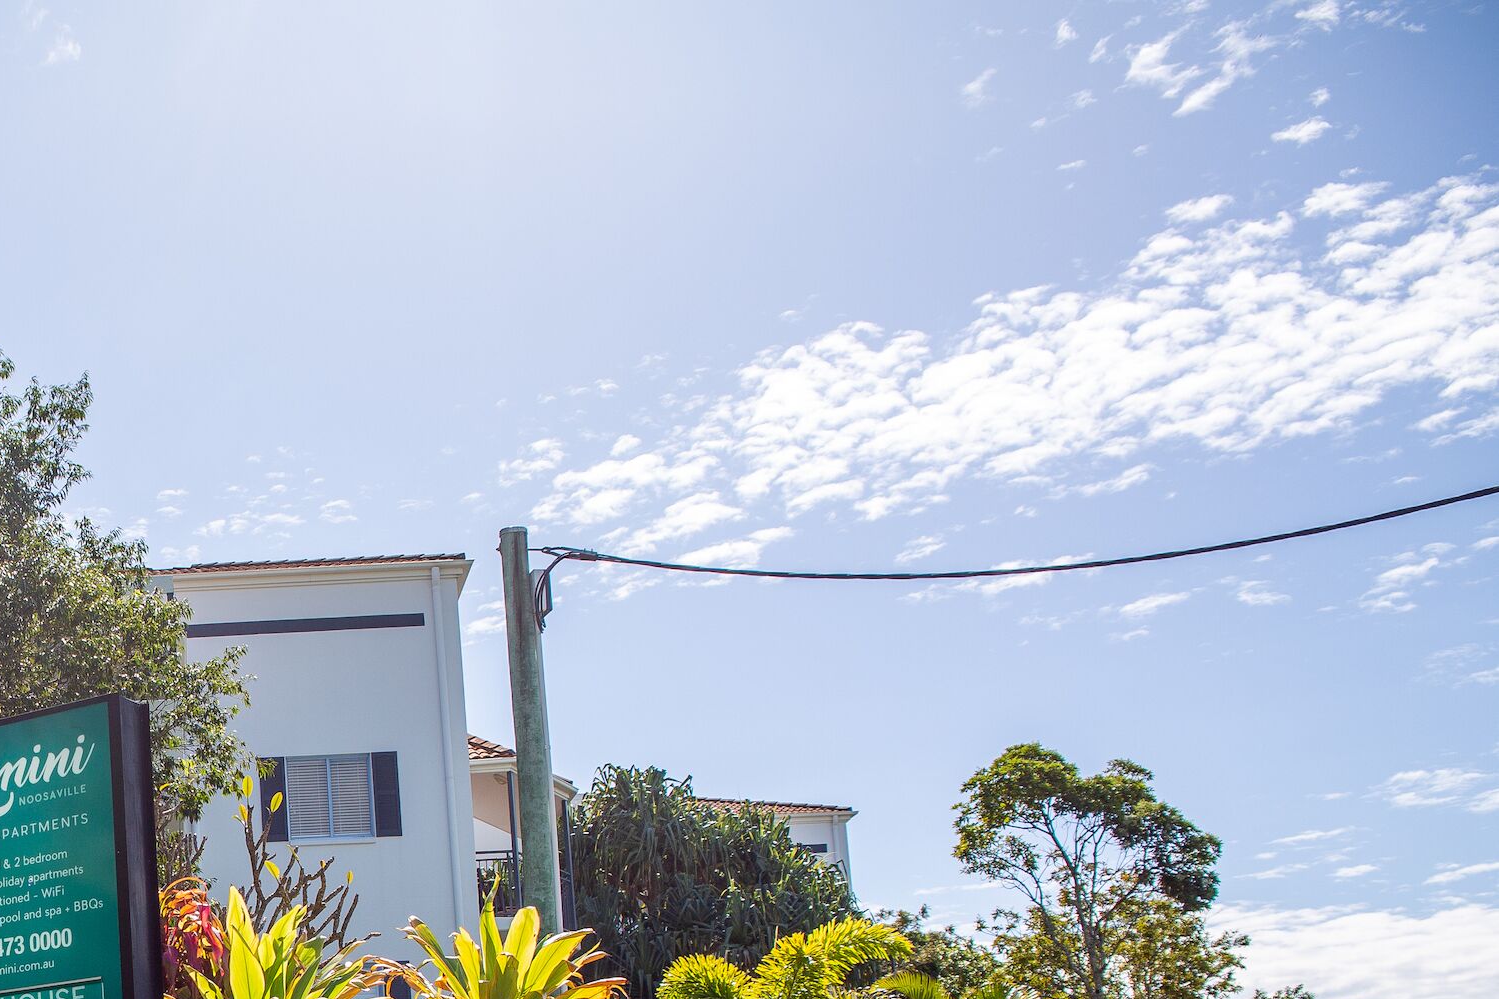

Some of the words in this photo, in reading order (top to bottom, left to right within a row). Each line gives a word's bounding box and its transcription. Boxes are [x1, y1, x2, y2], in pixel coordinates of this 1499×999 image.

[19, 784, 87, 806] NOOSAVILLE
[3, 858, 11, 869] &
[14, 856, 21, 868] 2
[23, 851, 68, 866] bedroom
[28, 864, 84, 886] apartments
[41, 885, 65, 899] WiFi
[0, 913, 21, 927] pool
[23, 908, 42, 921] and
[45, 905, 62, 919] spa
[74, 898, 104, 913] BBQs
[29, 927, 73, 952] 0000
